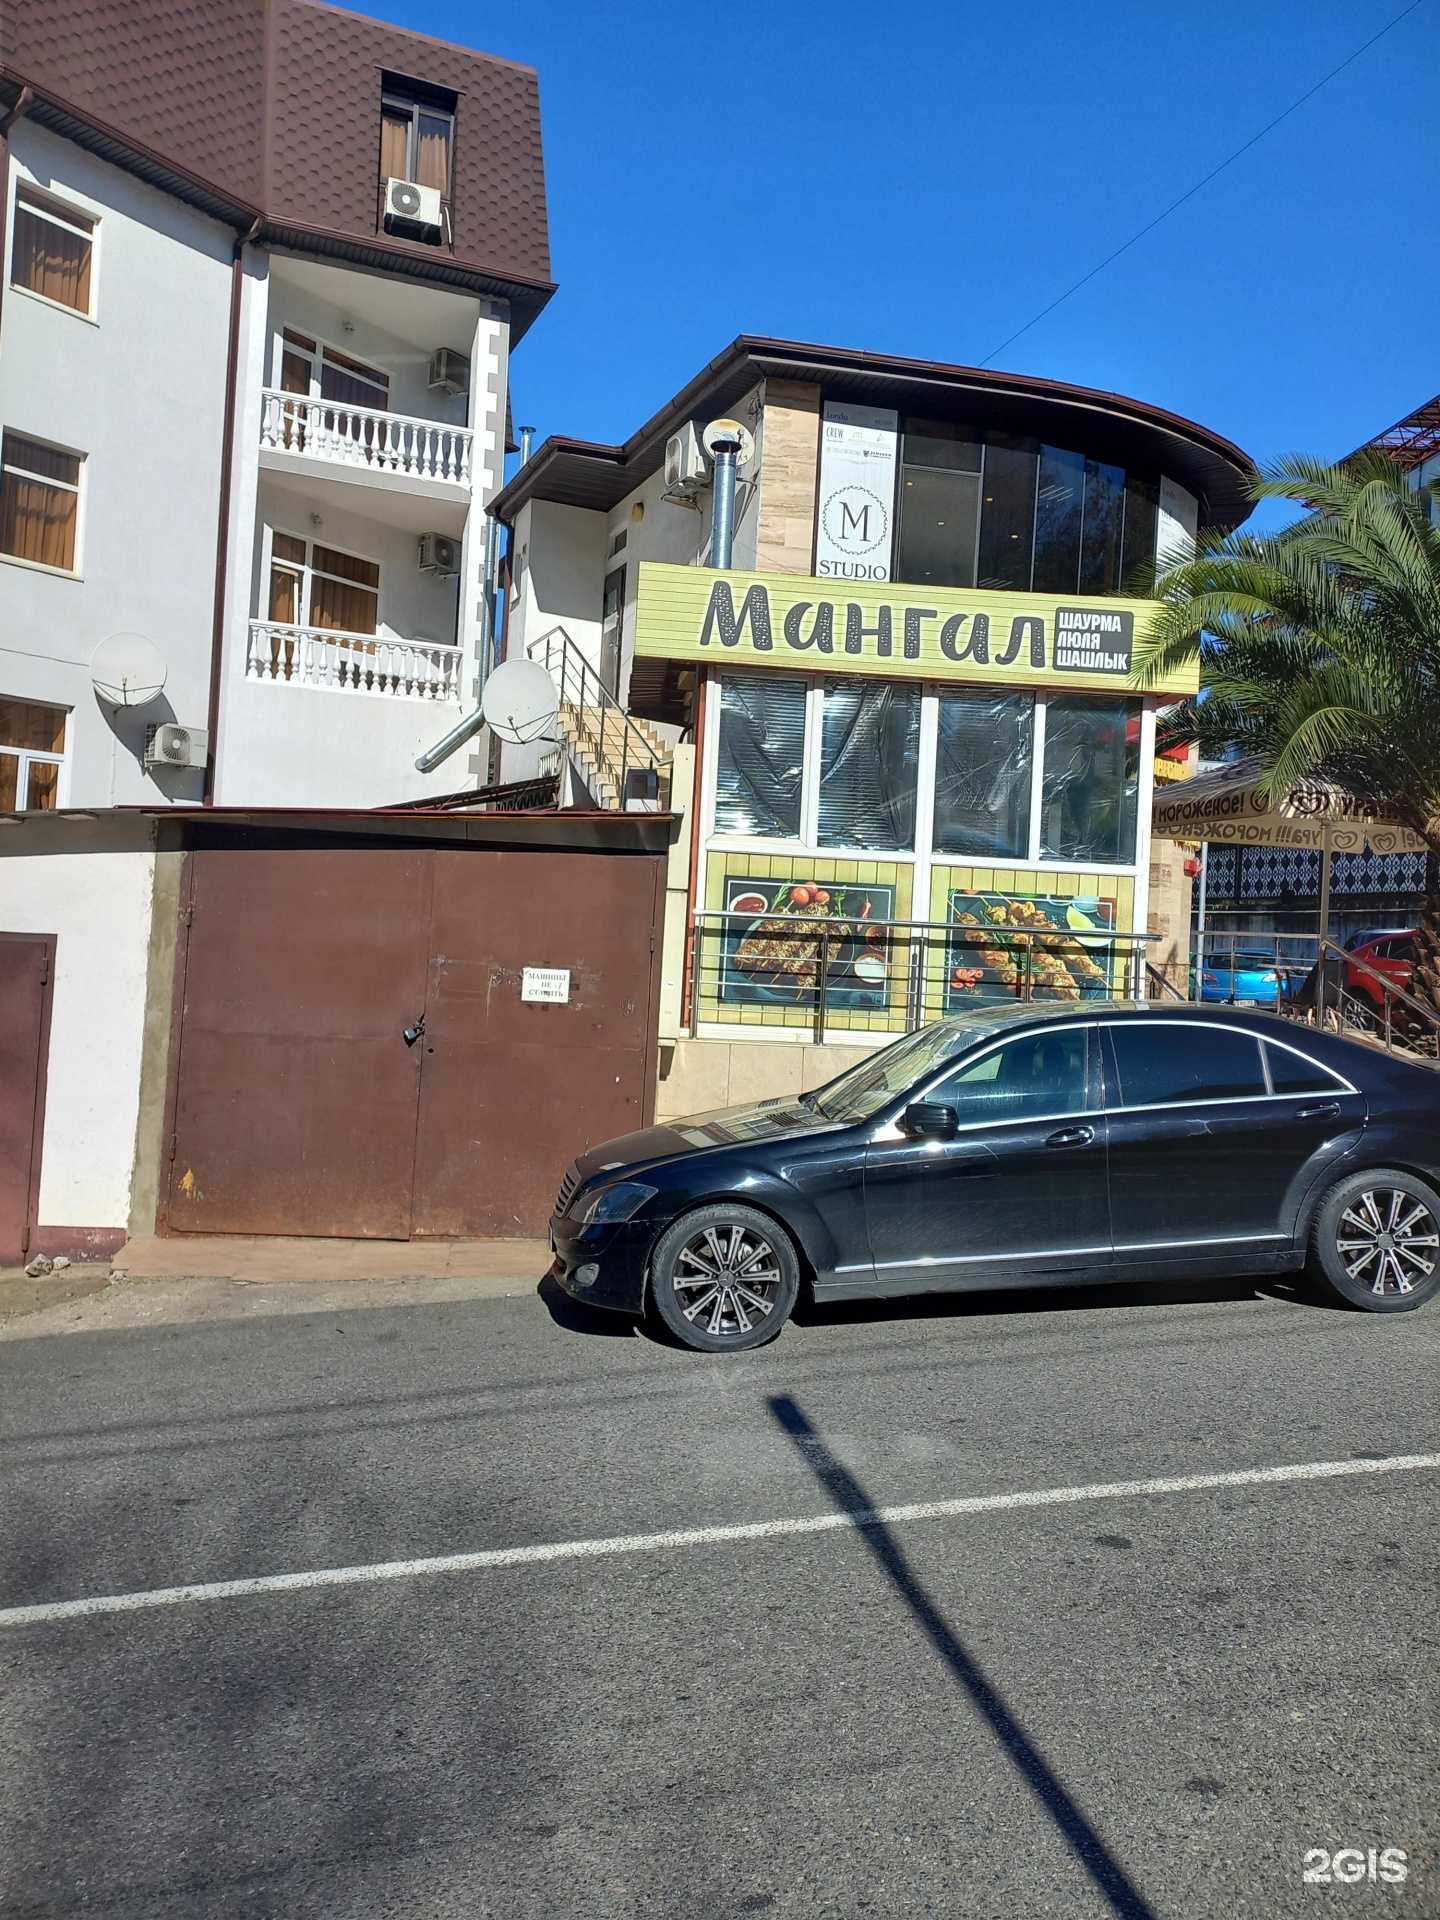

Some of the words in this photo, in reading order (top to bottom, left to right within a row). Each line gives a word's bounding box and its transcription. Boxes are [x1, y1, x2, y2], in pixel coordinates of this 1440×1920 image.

[838, 501, 872, 542] M
[819, 559, 887, 581] STUDIO
[700, 580, 1046, 668] Мангал
[1059, 612, 1121, 633] ШАУРМА
[1057, 632, 1101, 650] ЛЮЛЯ
[1056, 650, 1128, 670] ШАШЛЫК
